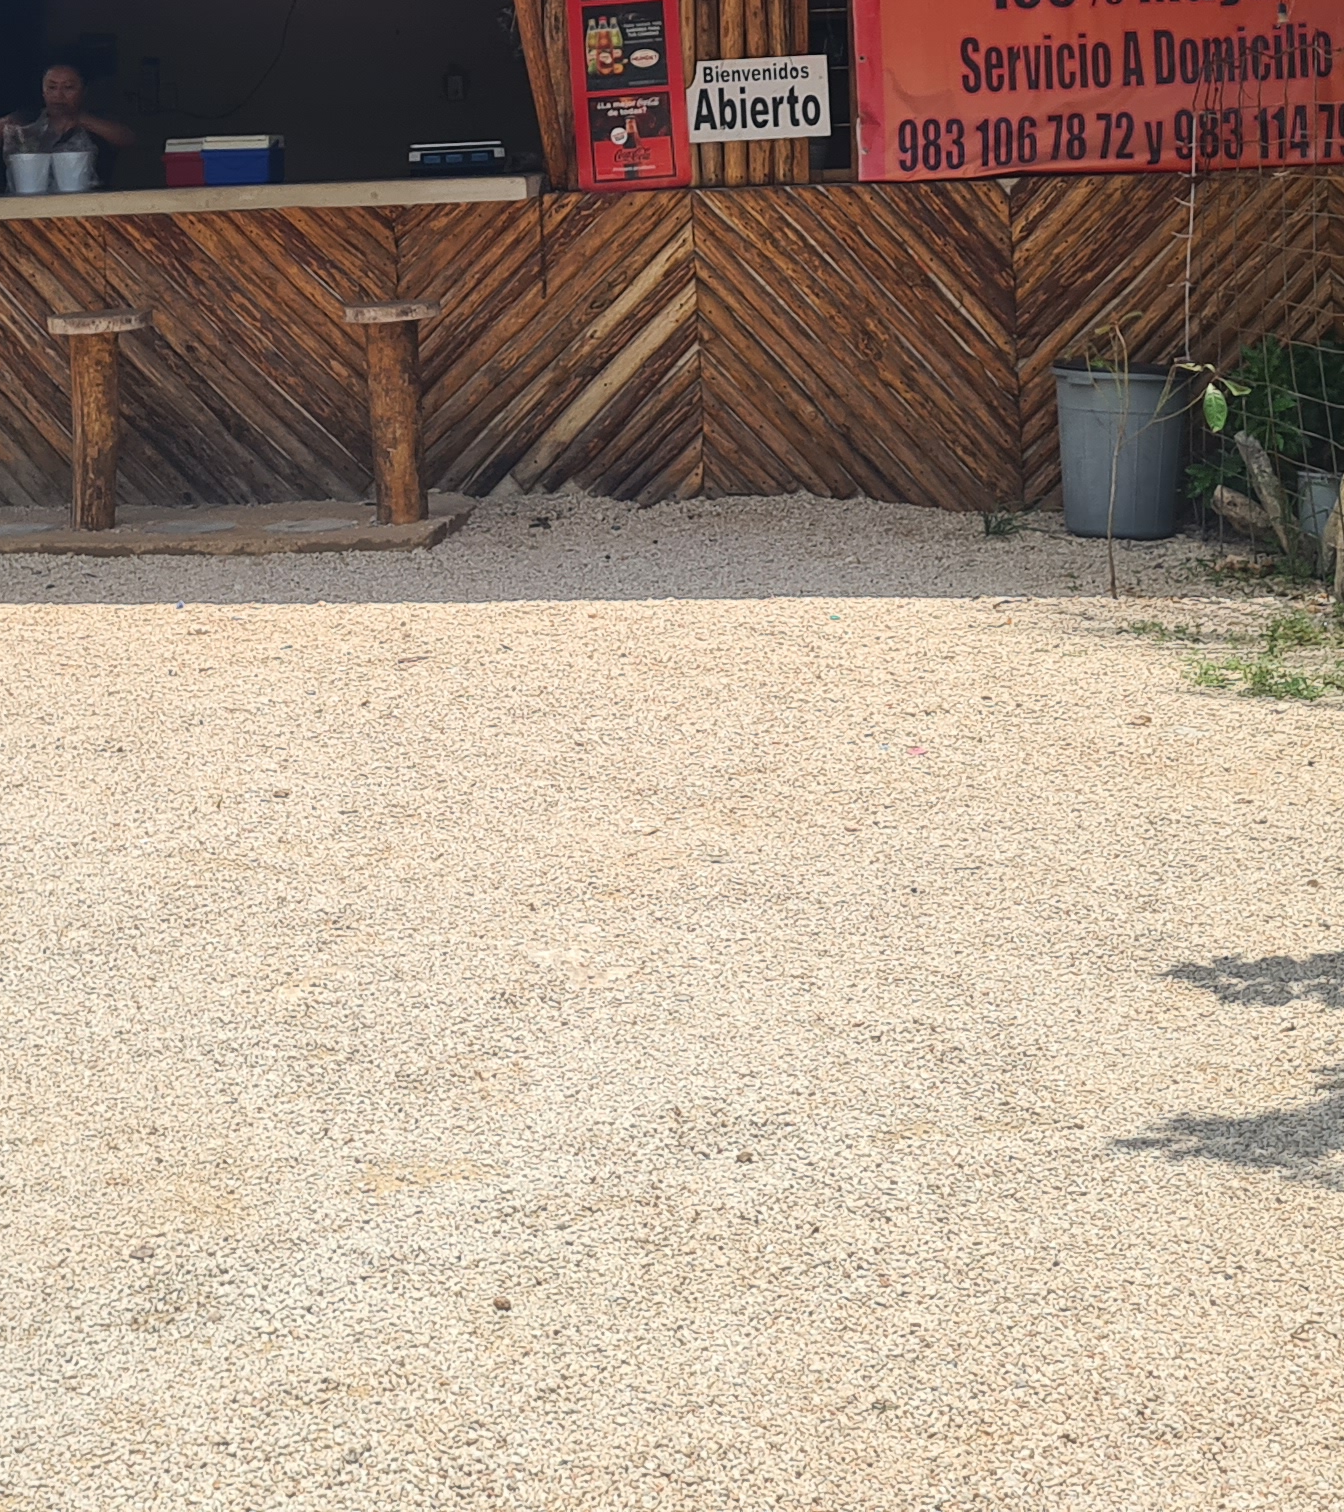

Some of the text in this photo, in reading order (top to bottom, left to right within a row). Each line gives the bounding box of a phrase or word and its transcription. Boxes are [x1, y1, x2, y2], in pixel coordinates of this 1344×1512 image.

[702, 62, 810, 84] Bienvenidos
[960, 24, 1333, 94] Servicio A Domicilio
[693, 85, 821, 131] Abierto
[897, 118, 966, 172] 983
[975, 116, 1038, 167] 106
[1047, 113, 1086, 161] 78
[1092, 111, 1135, 160] 72
[1144, 120, 1164, 165] y
[1174, 107, 1244, 161] 983
[1254, 105, 1310, 160] 114
